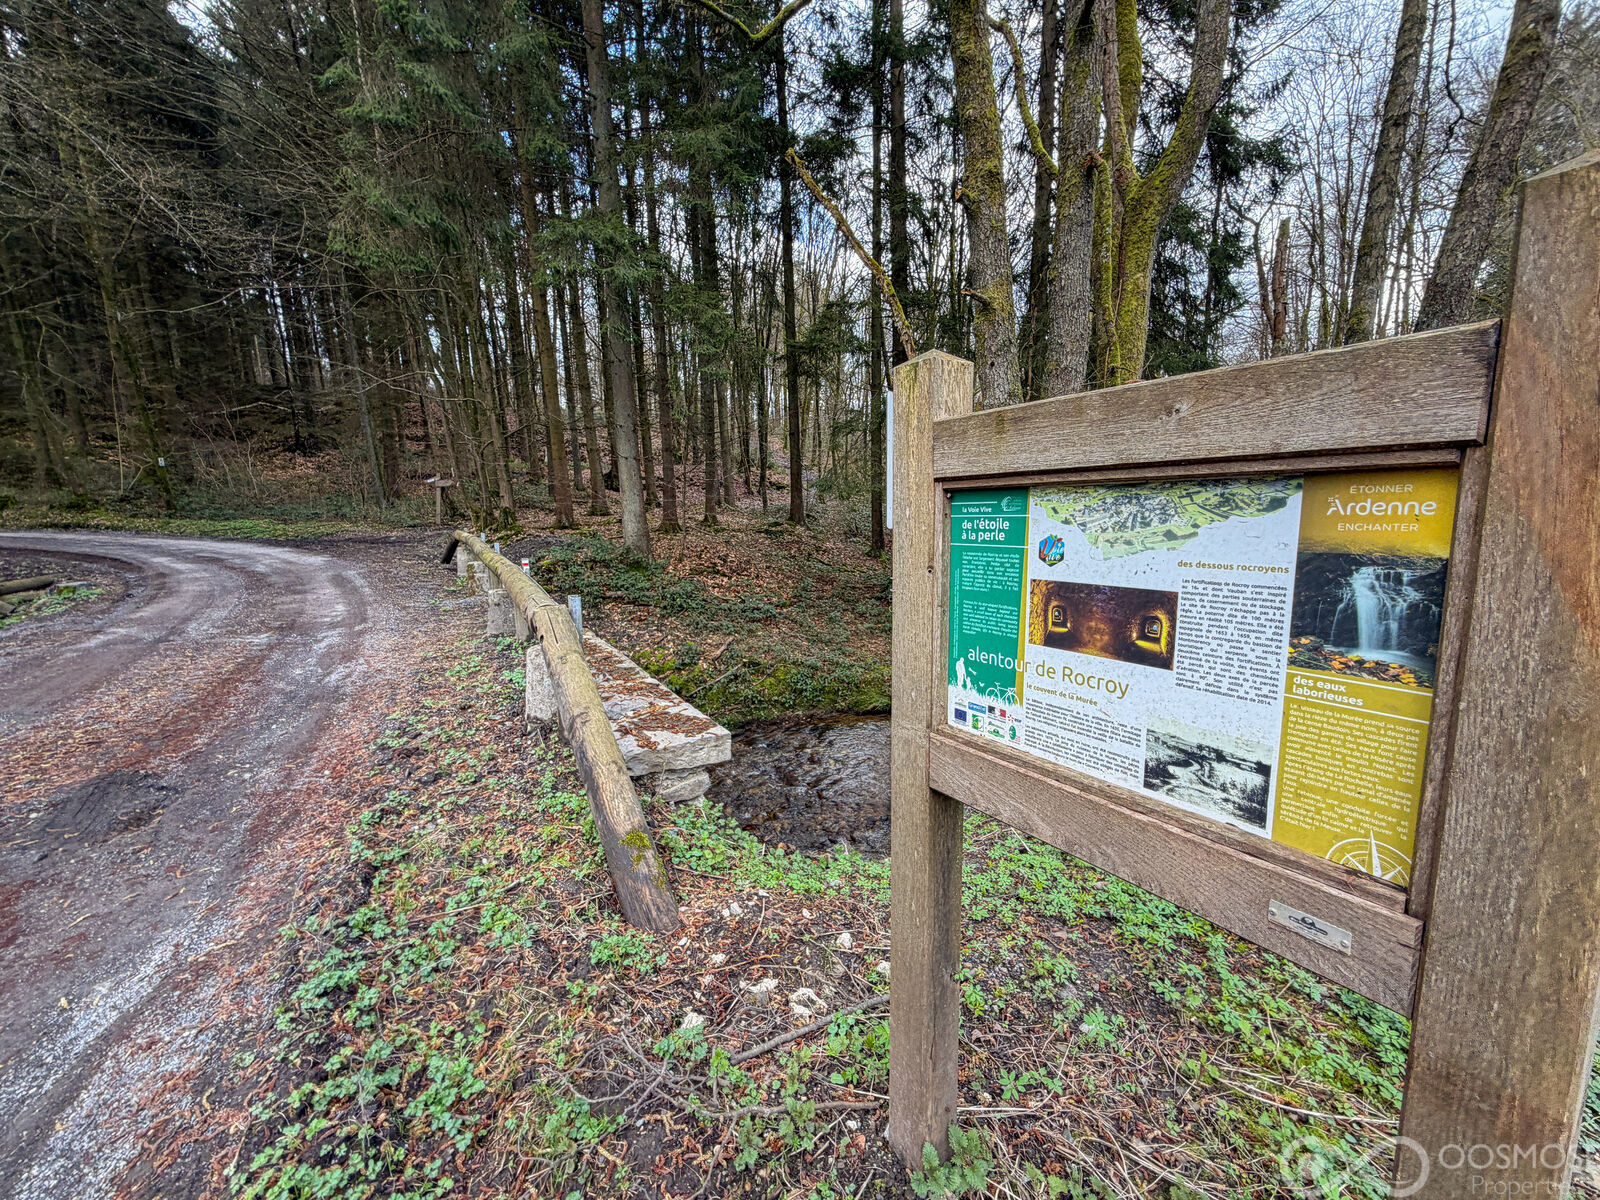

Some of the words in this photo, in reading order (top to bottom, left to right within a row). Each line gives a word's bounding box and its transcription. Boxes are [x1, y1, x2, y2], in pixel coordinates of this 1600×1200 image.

[962, 520, 972, 529] de
[974, 518, 1009, 529] l'étoile
[1337, 523, 1418, 532] ENCHANTER
[962, 530, 966, 539] à
[969, 530, 976, 540] la
[978, 530, 1005, 542] perle
[1196, 561, 1234, 570] dessous
[1237, 564, 1290, 574] rocroyens
[968, 646, 1031, 672] alentour
[1036, 660, 1056, 679] de
[1062, 666, 1129, 700] Rocroy
[1294, 676, 1314, 686] des
[1316, 681, 1346, 692] eaux
[1034, 686, 1057, 696] couvent
[1076, 695, 1097, 706] Murée
[1293, 685, 1363, 706] laborieuses
